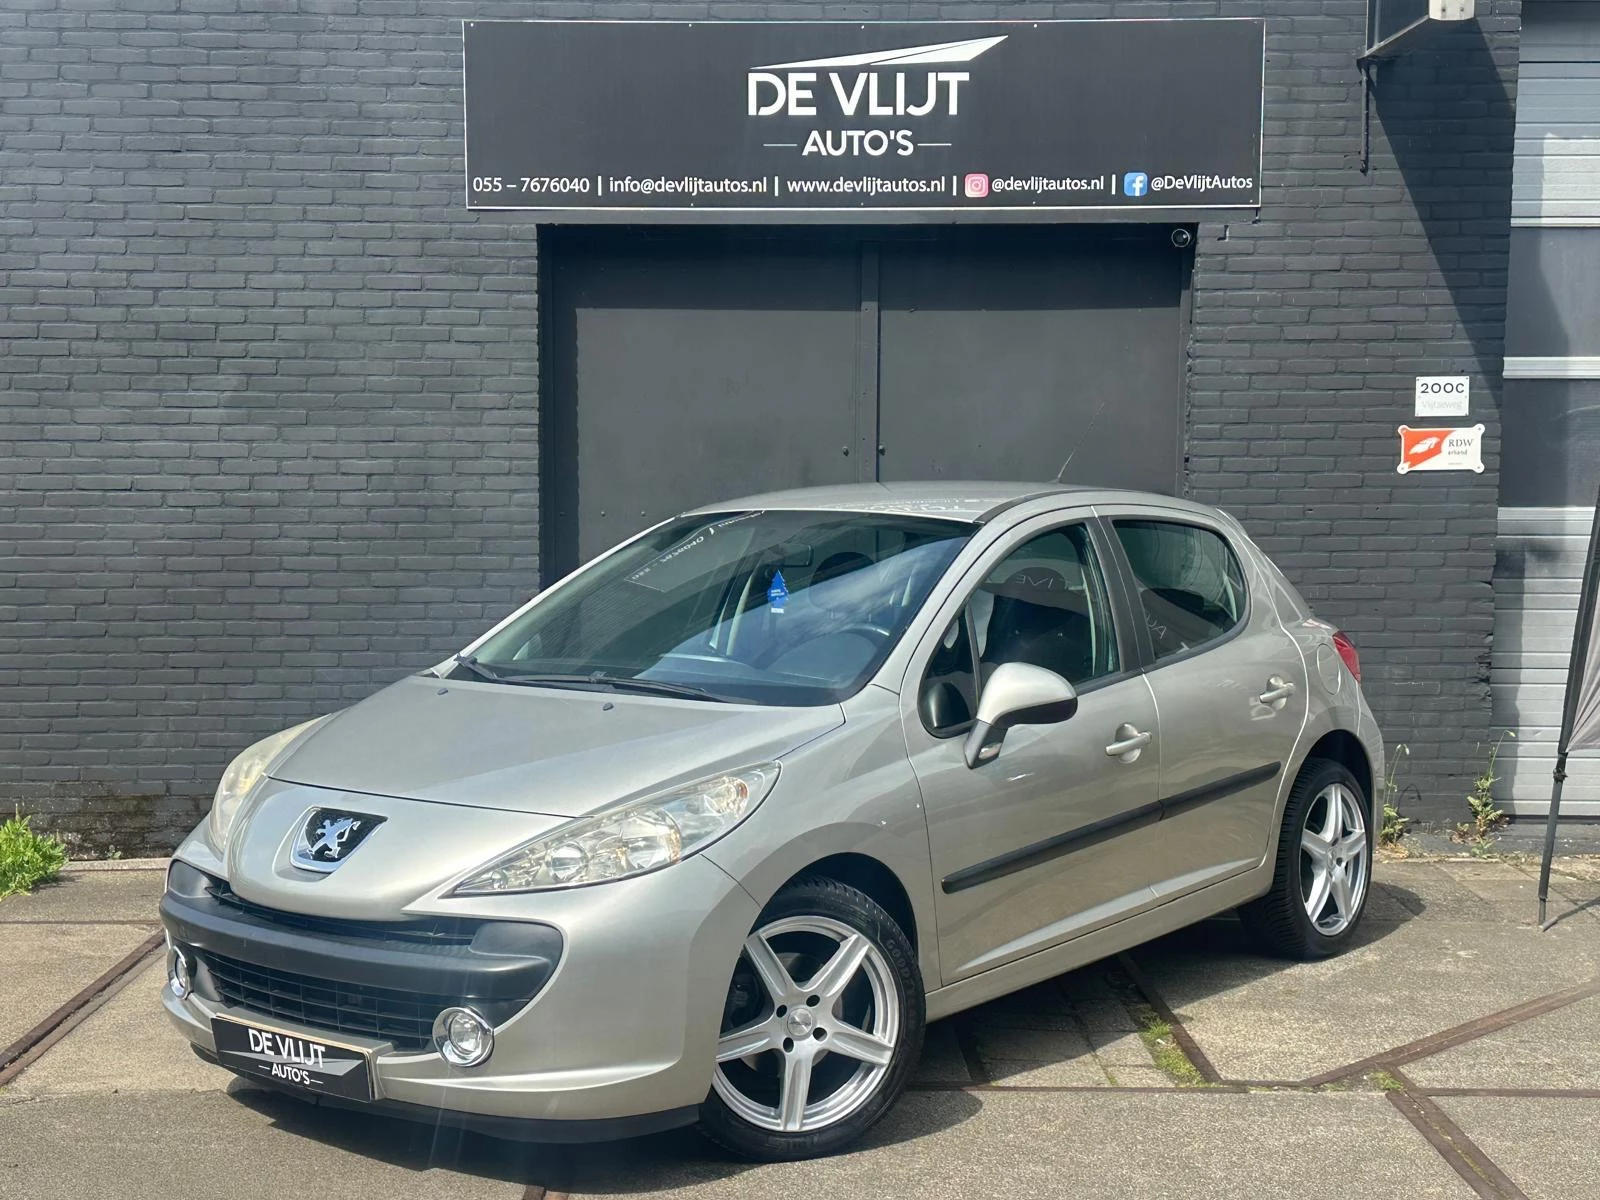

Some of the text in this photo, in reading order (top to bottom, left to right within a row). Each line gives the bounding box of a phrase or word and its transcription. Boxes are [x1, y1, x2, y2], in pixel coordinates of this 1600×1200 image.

[747, 71, 970, 117] DE VLIJT
[801, 129, 914, 157] AUTO'S
[472, 177, 503, 193] 055
[520, 177, 591, 193] 7676040
[609, 175, 767, 196] info@devlijtautos.nl
[786, 175, 946, 196] www.devlijtautos.nl
[991, 175, 1105, 195] @devlijtautos.nl
[1150, 175, 1253, 193] @DeVlijtAutos
[1420, 382, 1465, 394] 200C
[1448, 439, 1474, 448] RDW
[248, 1028, 326, 1069] DE VLIJT
[271, 1062, 311, 1085] AUTO'S
